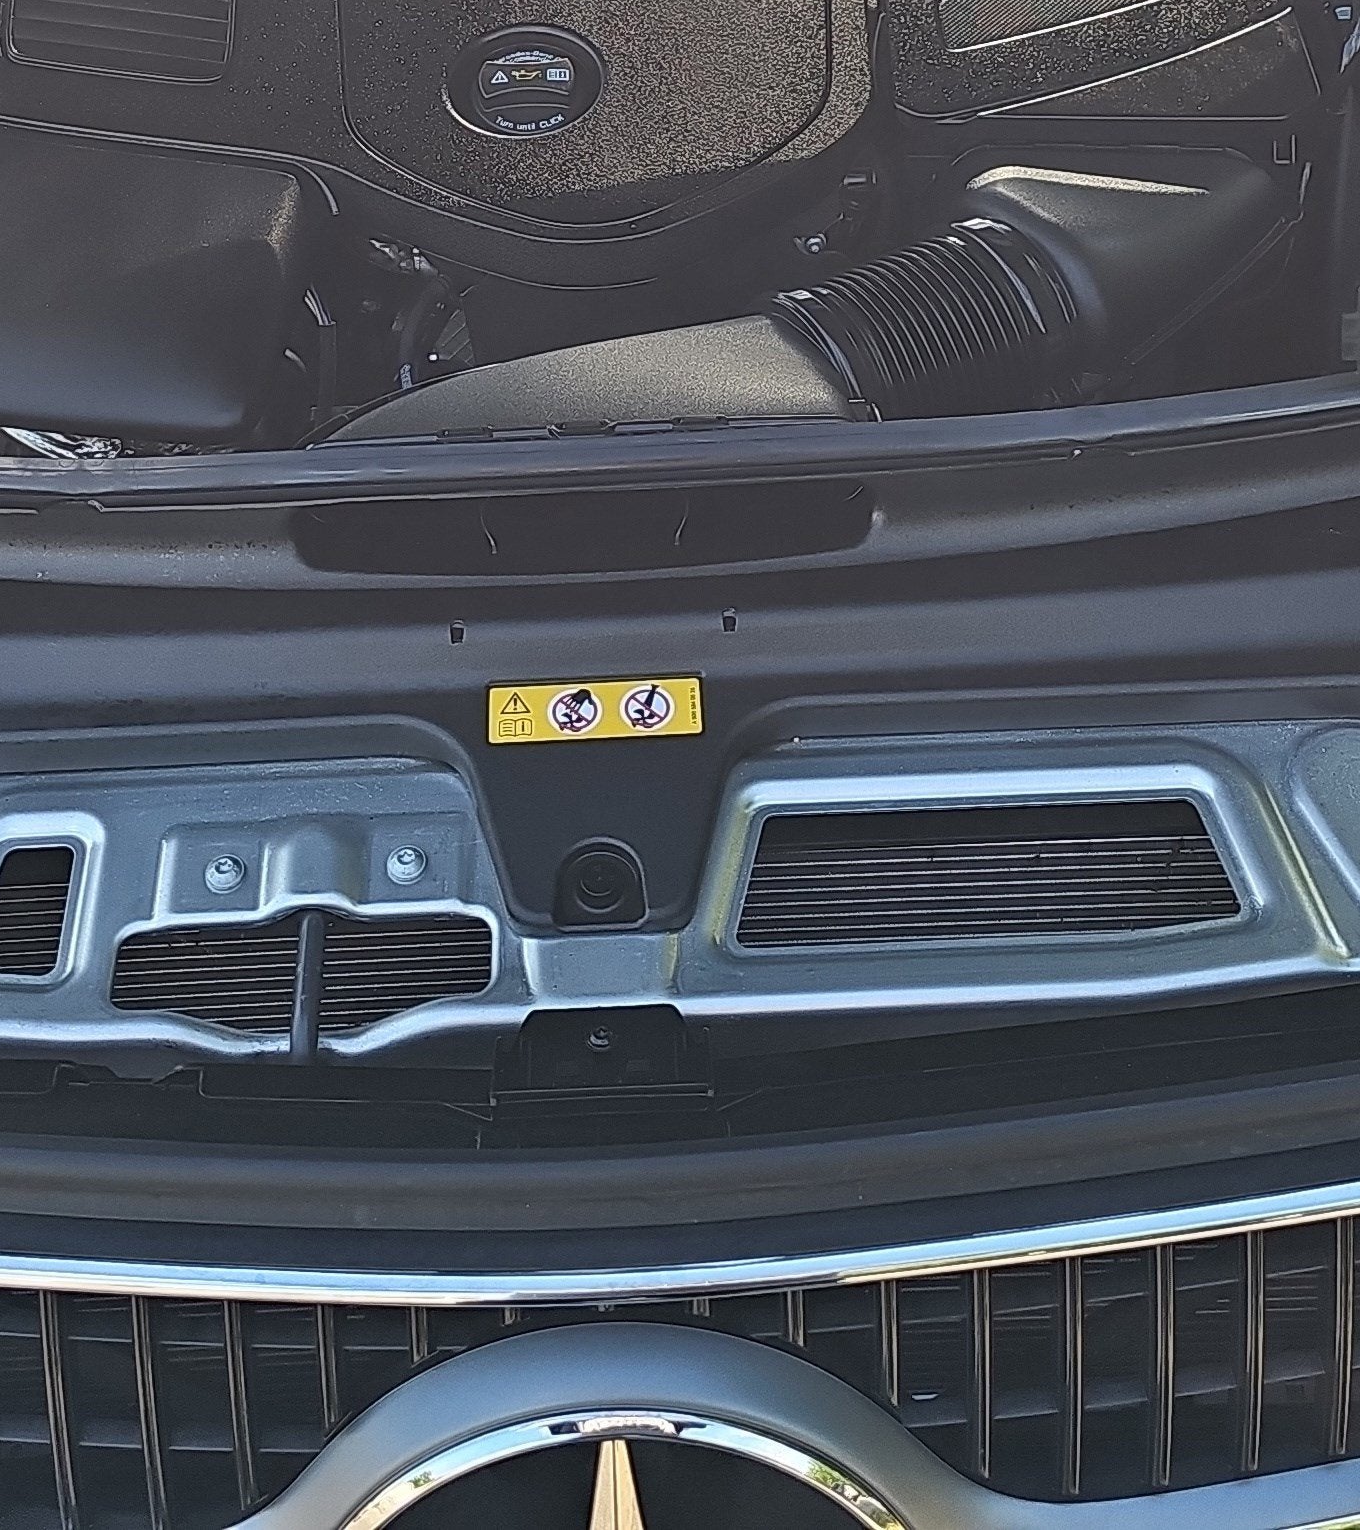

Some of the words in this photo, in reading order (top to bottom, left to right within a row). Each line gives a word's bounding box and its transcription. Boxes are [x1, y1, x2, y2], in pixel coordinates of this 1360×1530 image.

[495, 115, 514, 129] Turn
[516, 122, 536, 130] until
[539, 113, 565, 129] CLICK
